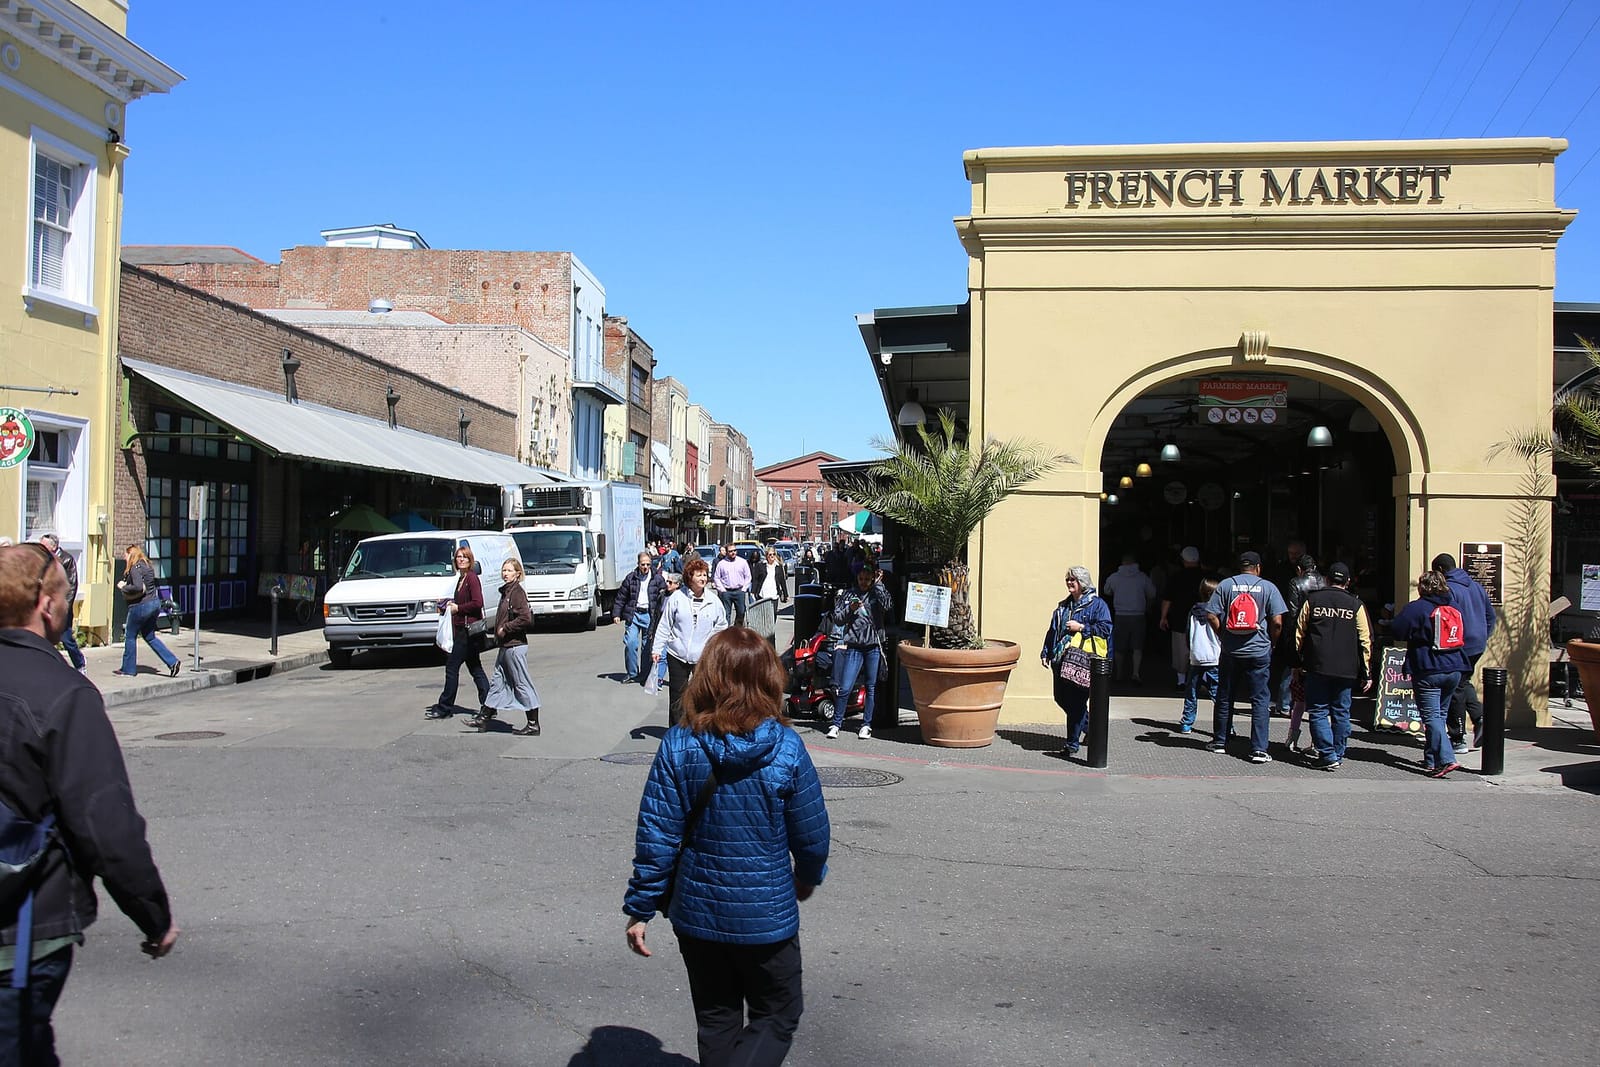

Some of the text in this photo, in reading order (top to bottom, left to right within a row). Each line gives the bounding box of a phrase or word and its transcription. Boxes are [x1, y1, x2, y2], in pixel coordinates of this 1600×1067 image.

[1065, 165, 1451, 208] FRENCH MARKET
[1313, 607, 1354, 620] SAINTS
[1384, 708, 1403, 716] REAL
